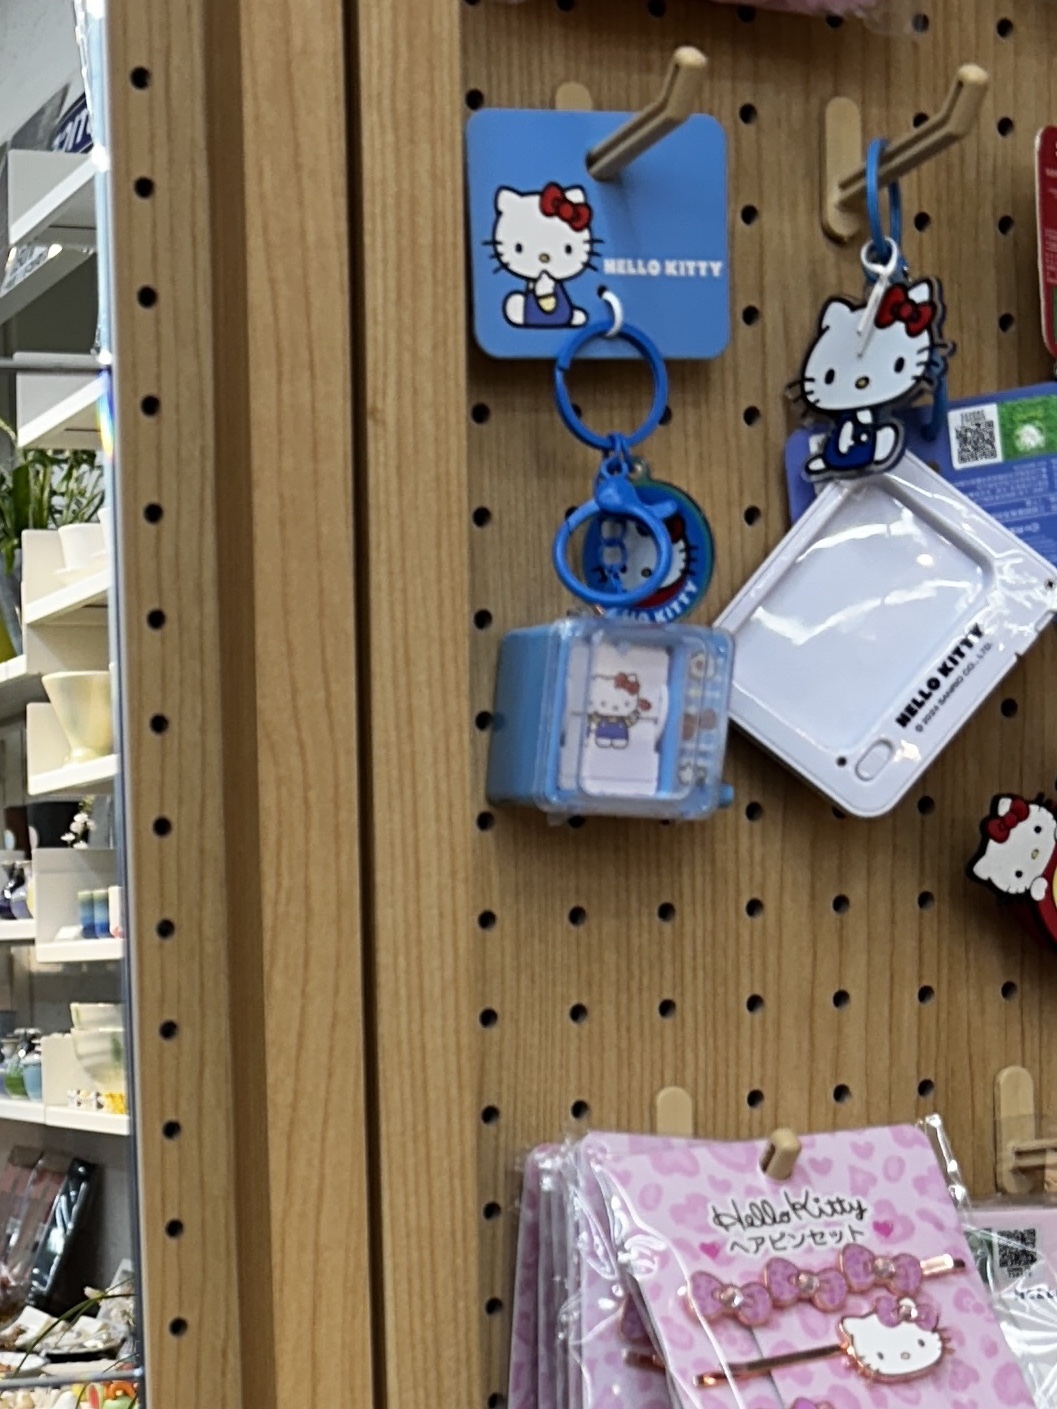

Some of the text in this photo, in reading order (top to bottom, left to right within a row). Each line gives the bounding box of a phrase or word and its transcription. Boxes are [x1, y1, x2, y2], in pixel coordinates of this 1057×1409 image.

[603, 258, 723, 277] HELLO KITTY
[654, 580, 697, 623] KITTY
[895, 622, 983, 729] HELLO KITTY
[938, 675, 964, 706] SANRIO
[711, 1189, 867, 1232] Hello Kitty
[730, 1224, 864, 1254] ヘアピンセット
